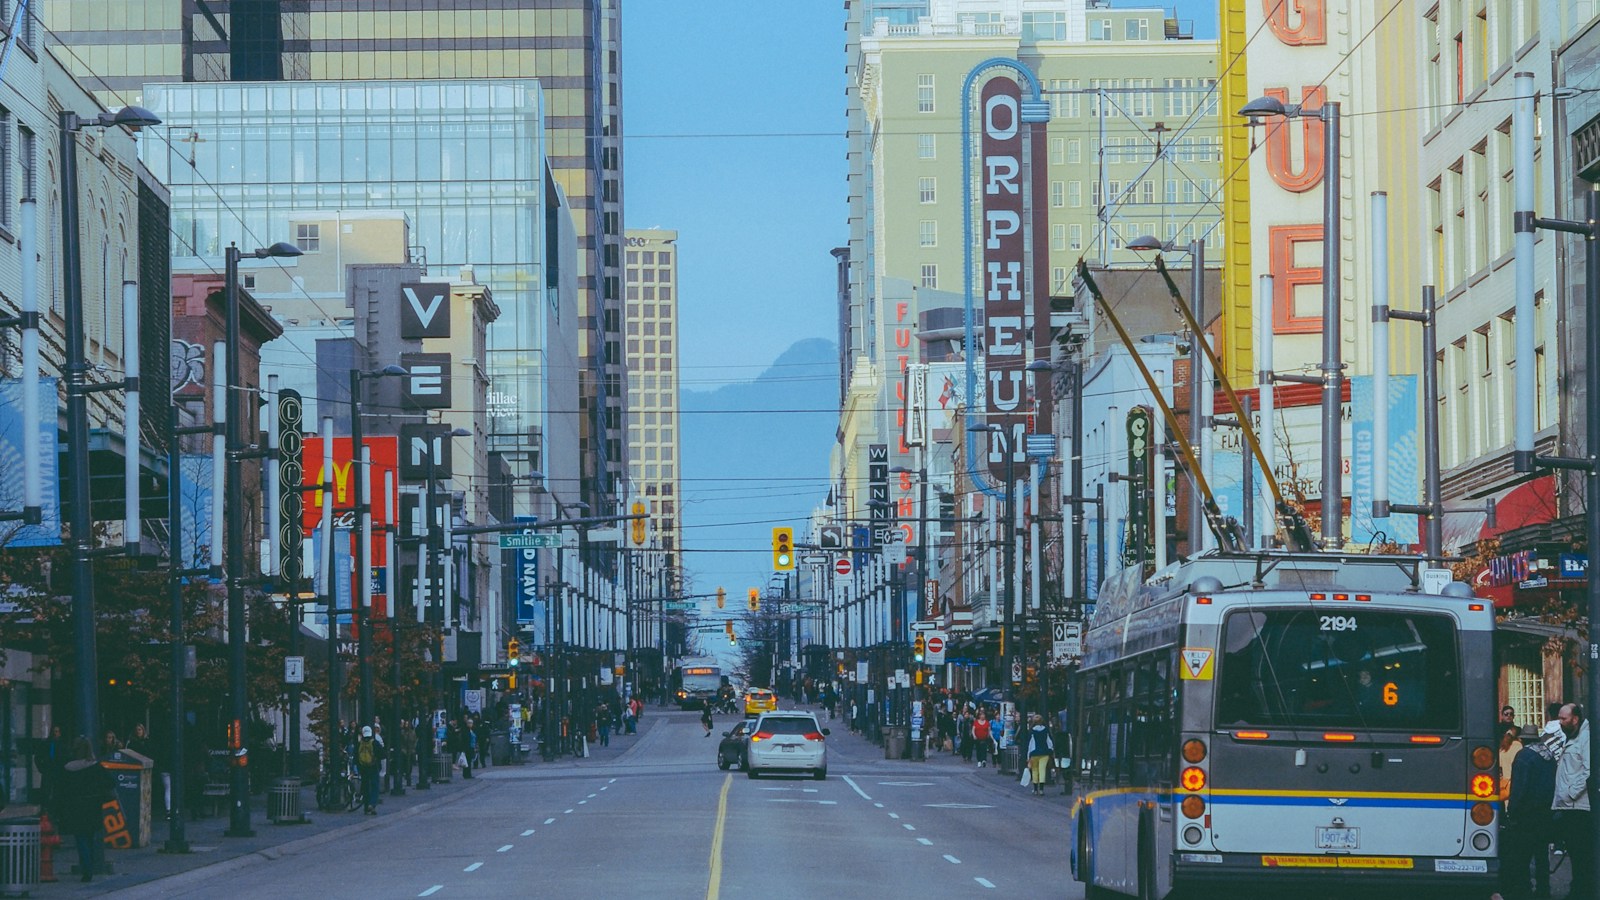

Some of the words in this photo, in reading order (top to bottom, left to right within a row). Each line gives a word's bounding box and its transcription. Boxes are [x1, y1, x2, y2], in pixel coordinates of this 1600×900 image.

[985, 94, 1026, 462] ORPHEUM
[523, 563, 536, 607] NAVY
[1320, 616, 1357, 631] 2194
[1383, 682, 1398, 706] 6
